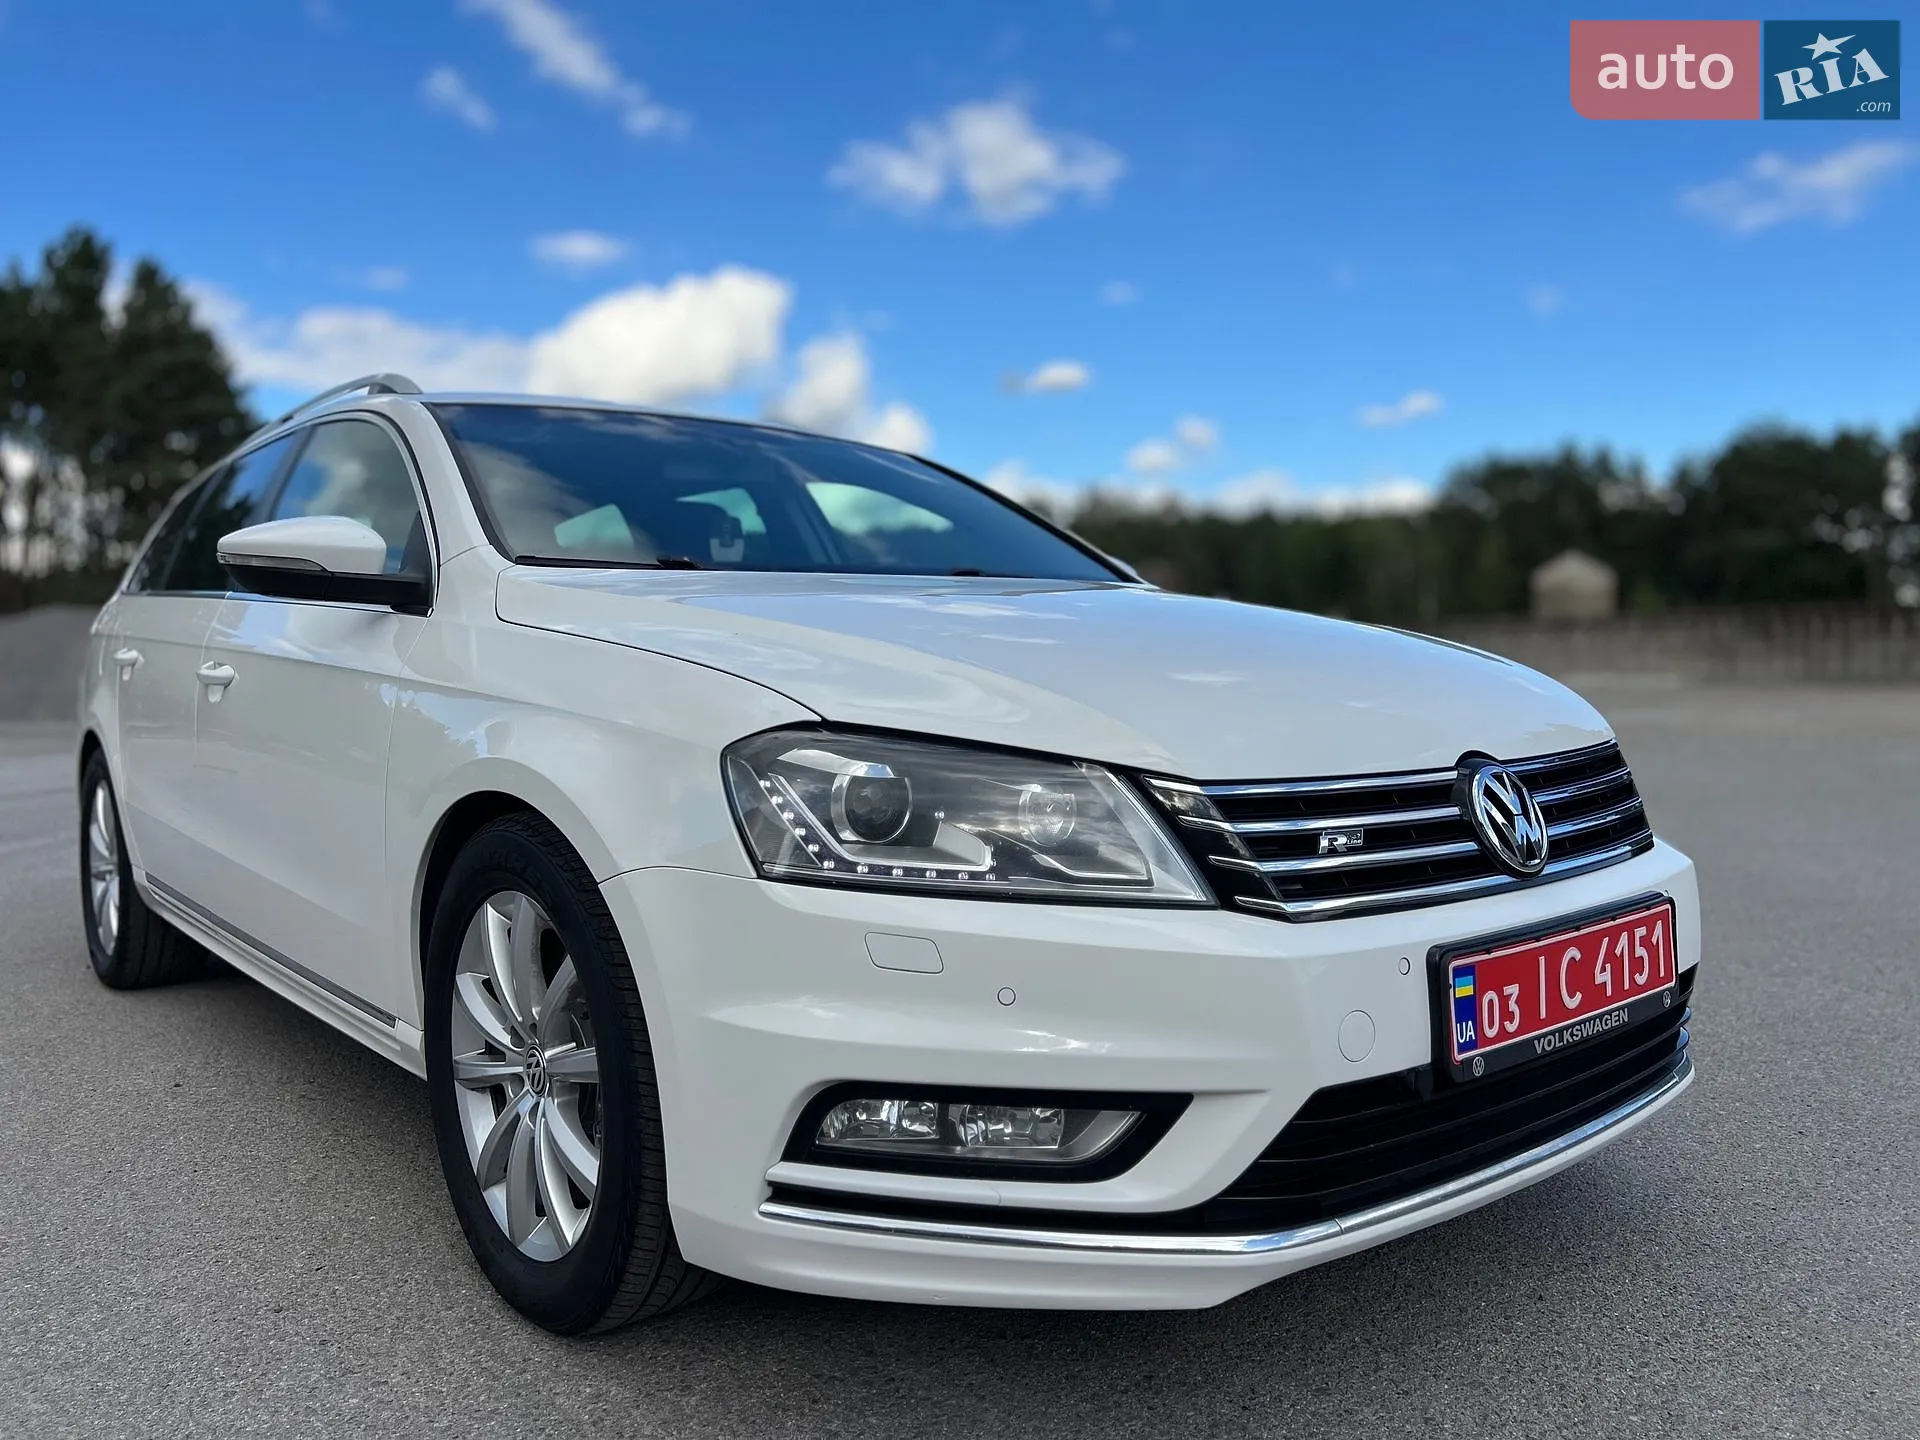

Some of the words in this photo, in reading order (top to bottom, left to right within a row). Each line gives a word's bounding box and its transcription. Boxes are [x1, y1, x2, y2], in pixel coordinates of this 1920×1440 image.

[1482, 983, 1521, 1039] 03
[1594, 919, 1664, 997] 4151
[1457, 1020, 1476, 1044] UA
[1534, 1007, 1629, 1055] VOLKSWAGEN
